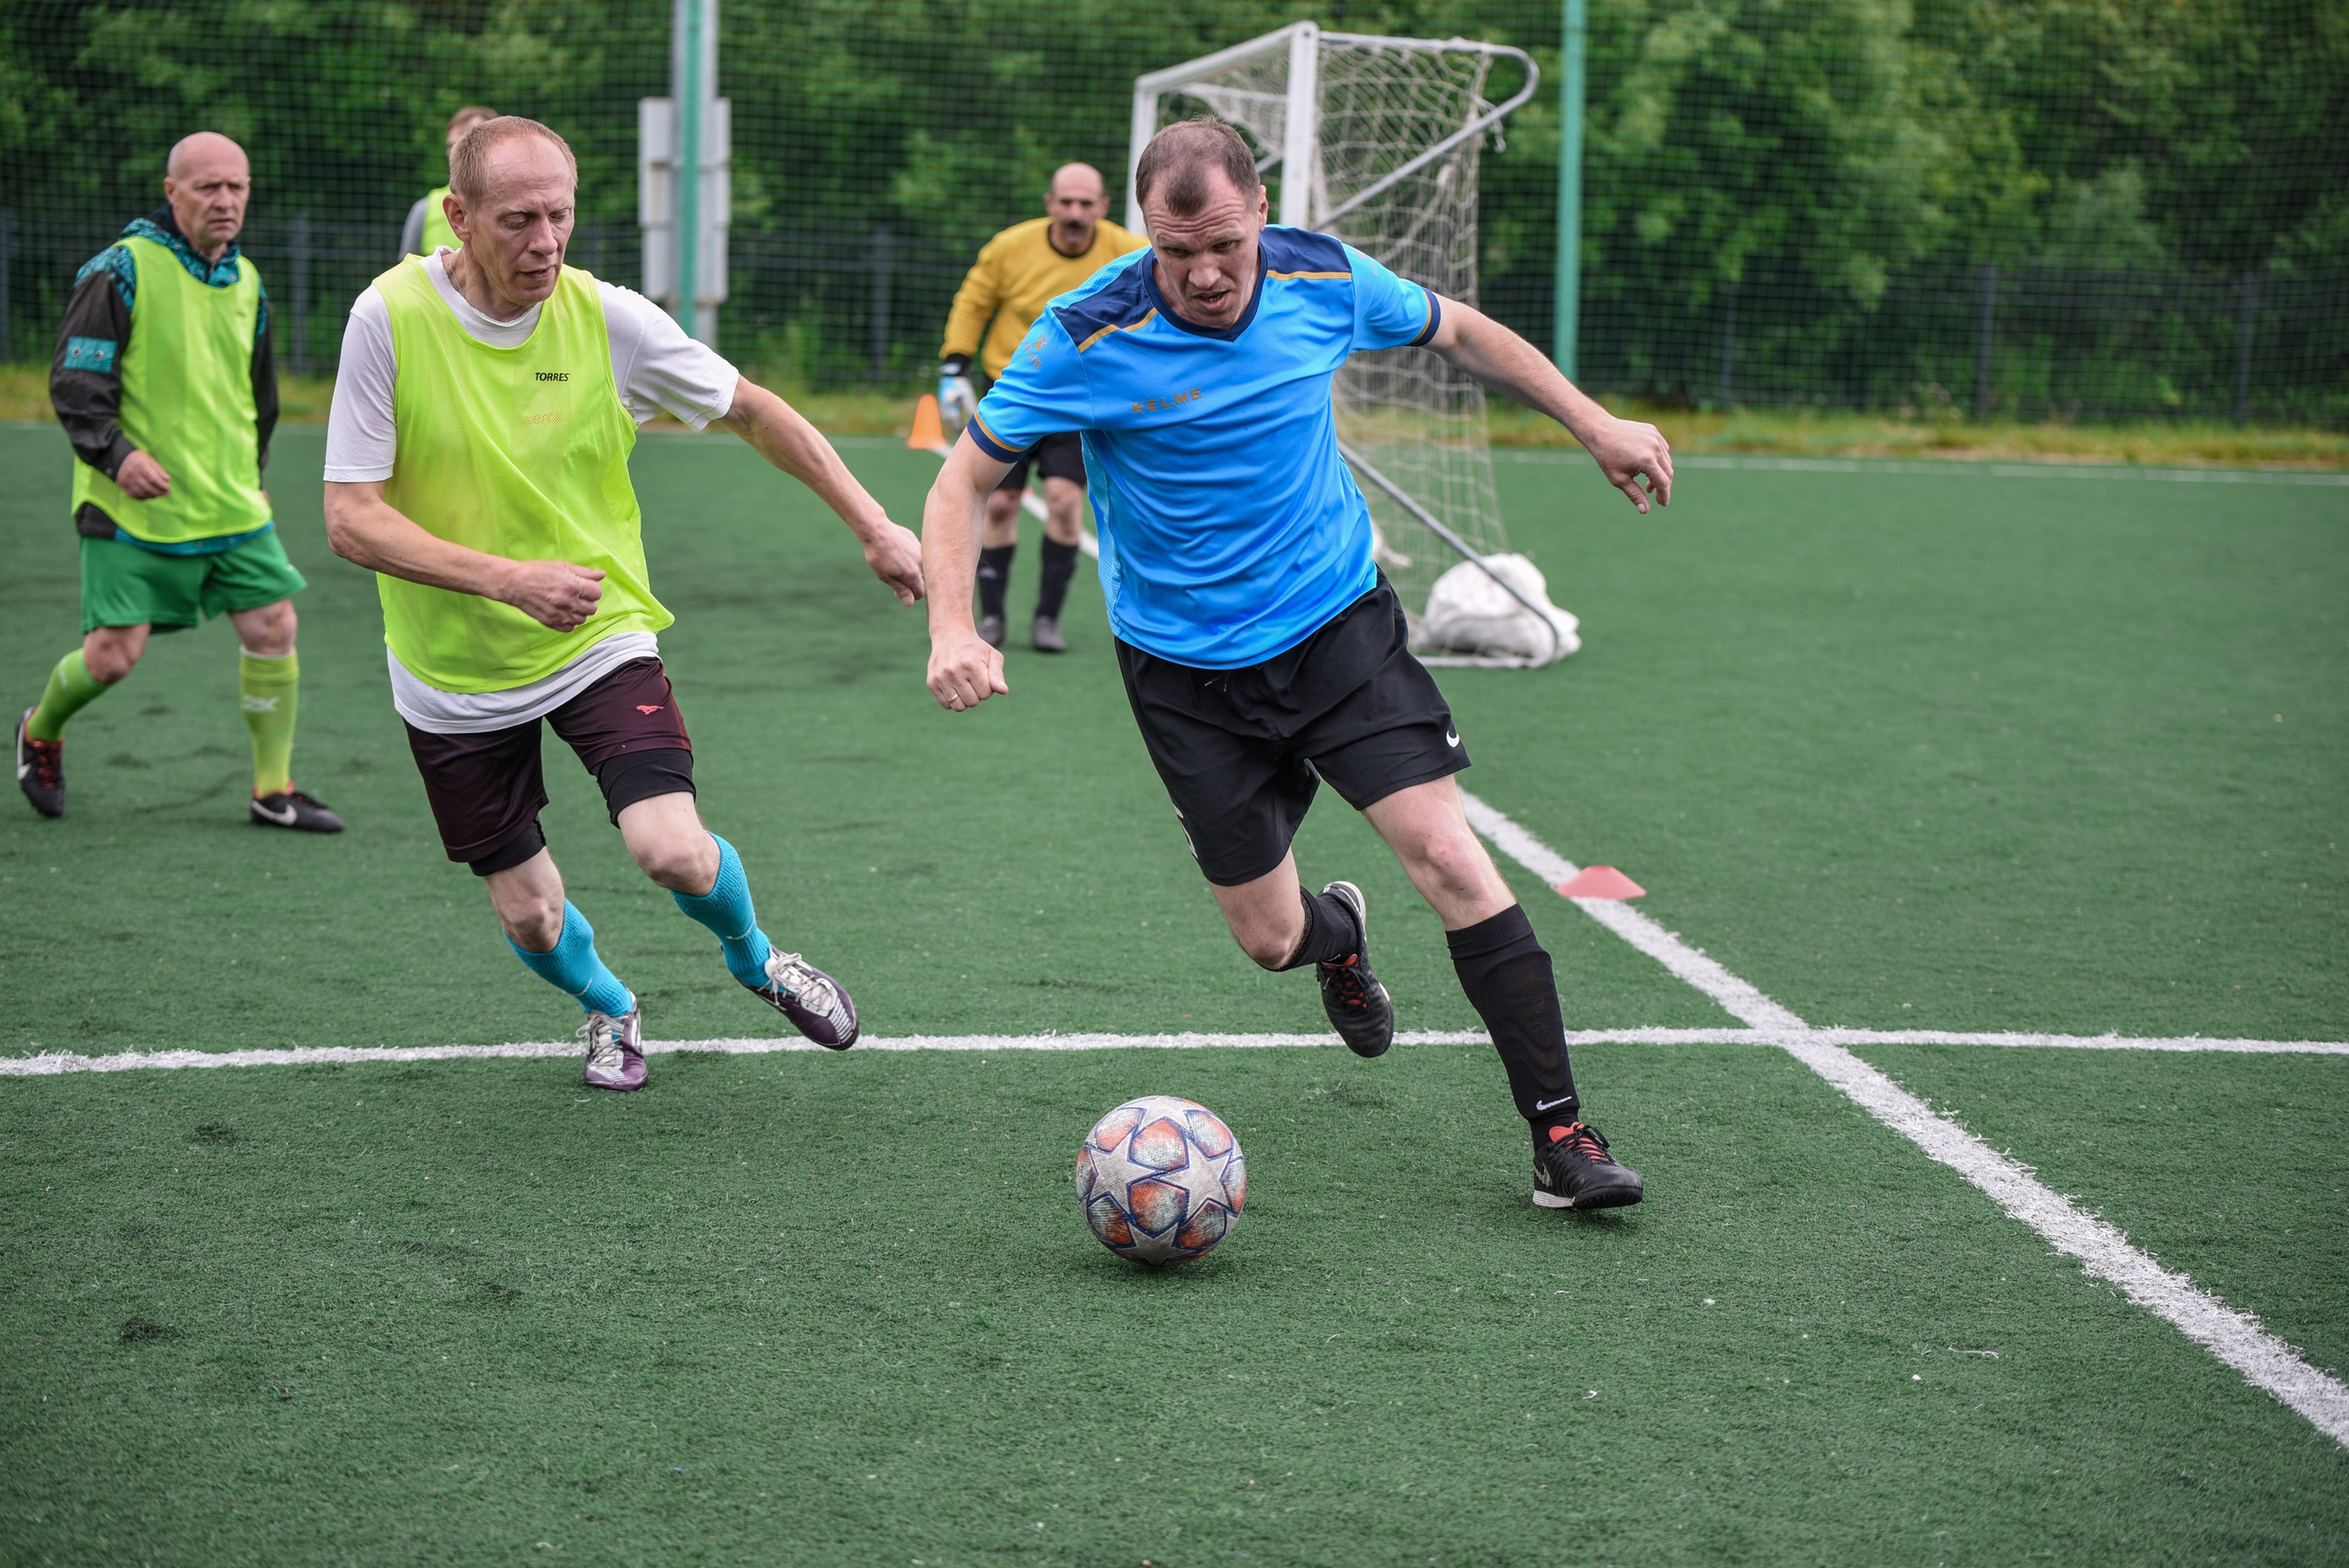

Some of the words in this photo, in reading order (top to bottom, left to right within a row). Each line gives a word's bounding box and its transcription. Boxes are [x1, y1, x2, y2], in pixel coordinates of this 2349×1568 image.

[1024, 339, 1042, 371] KELME
[535, 372, 569, 382] TORRES
[1132, 387, 1203, 415] KELME
